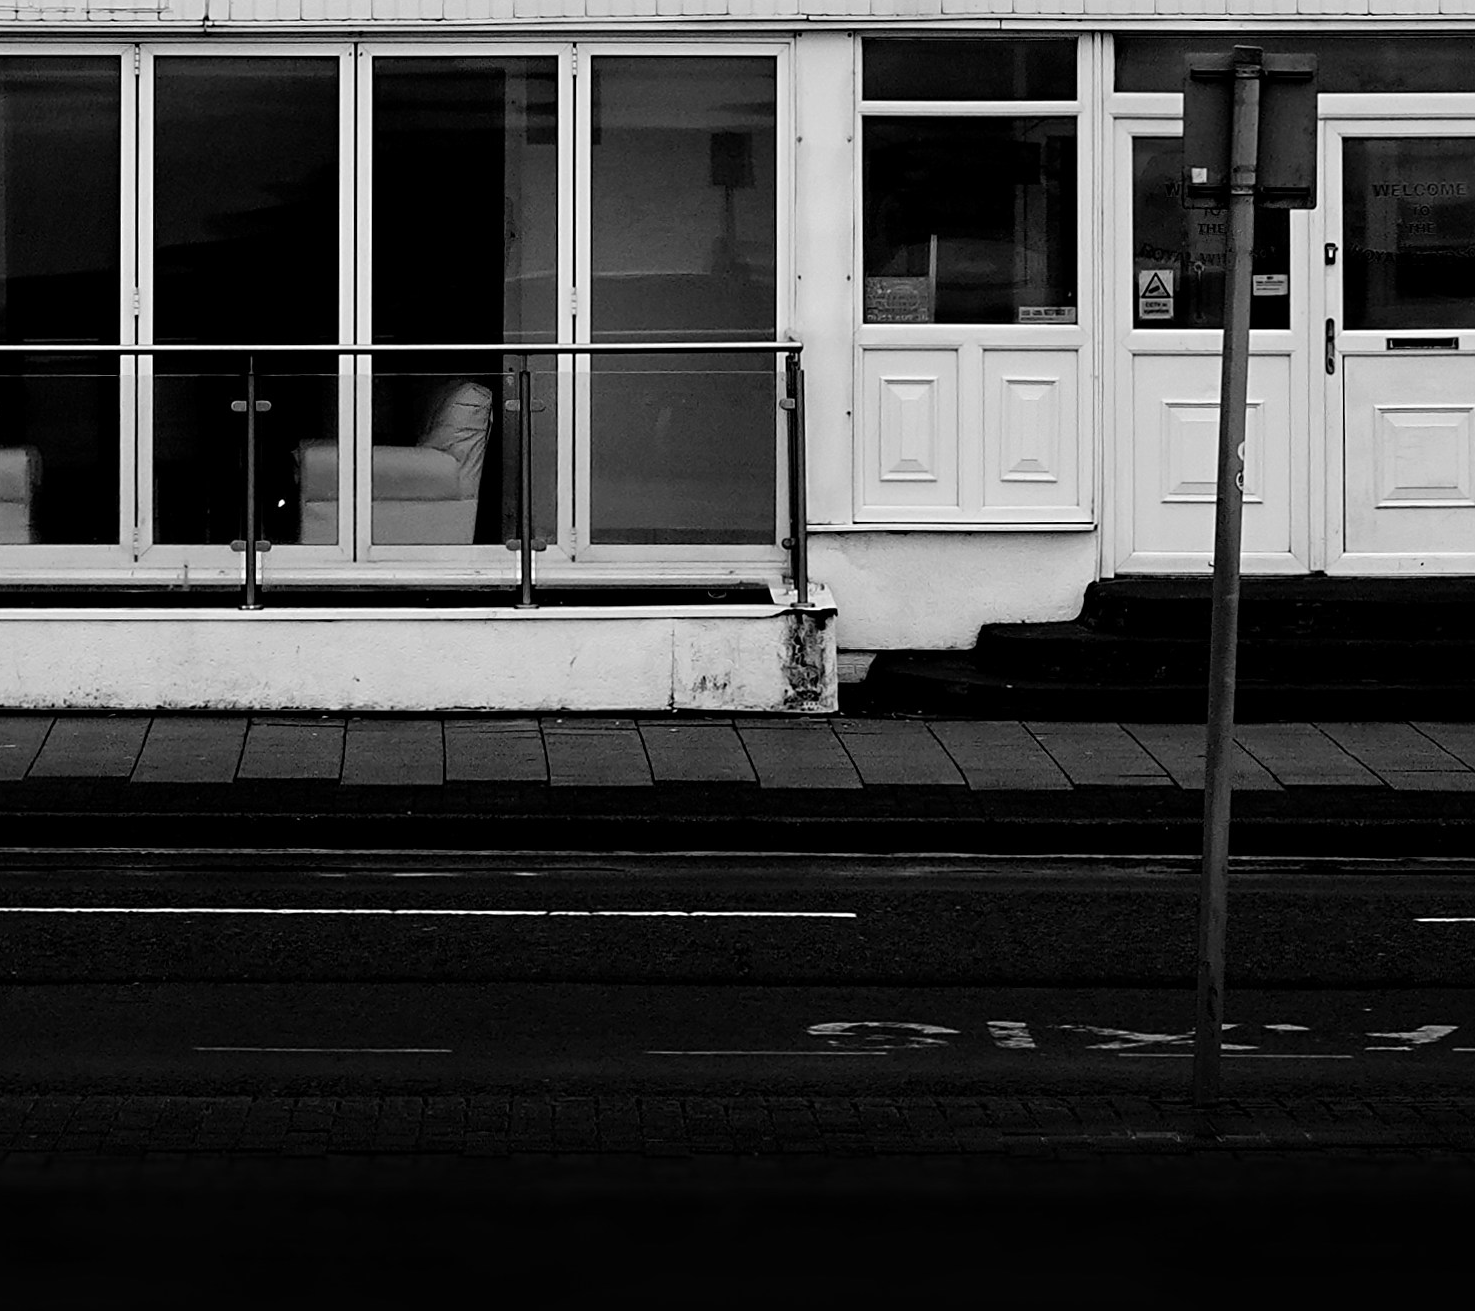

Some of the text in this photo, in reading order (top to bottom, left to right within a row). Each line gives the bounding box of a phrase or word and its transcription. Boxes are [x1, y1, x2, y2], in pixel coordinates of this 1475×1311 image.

[1372, 183, 1467, 196] WELCOME
[1198, 223, 1225, 234] THE
[1408, 223, 1436, 234] THE
